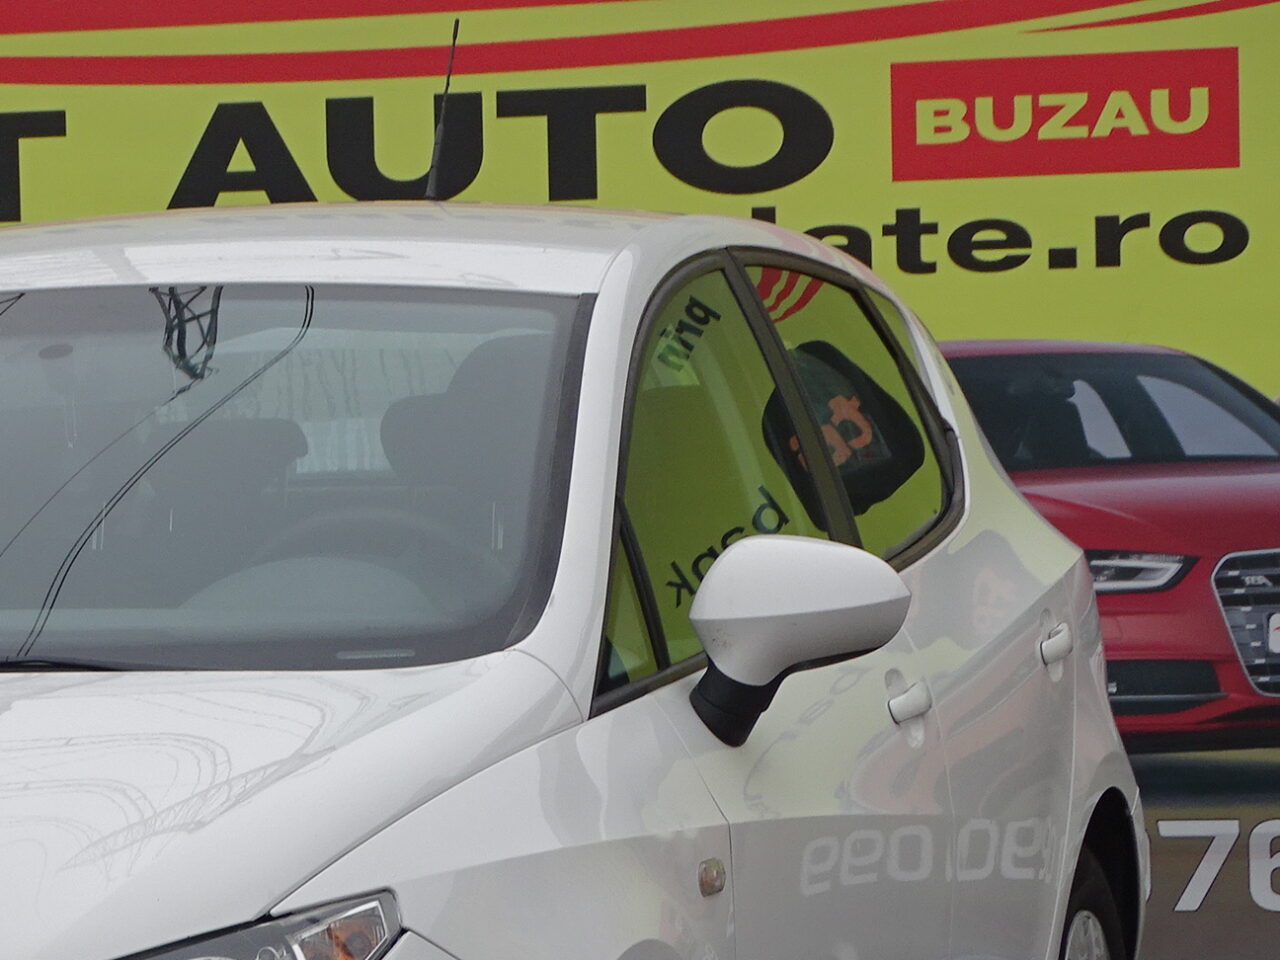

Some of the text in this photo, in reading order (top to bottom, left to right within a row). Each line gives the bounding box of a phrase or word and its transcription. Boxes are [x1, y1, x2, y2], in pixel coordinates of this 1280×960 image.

[166, 79, 835, 211] AUTO
[915, 86, 1211, 147] BUZAU
[751, 206, 1250, 275] ate.ro
